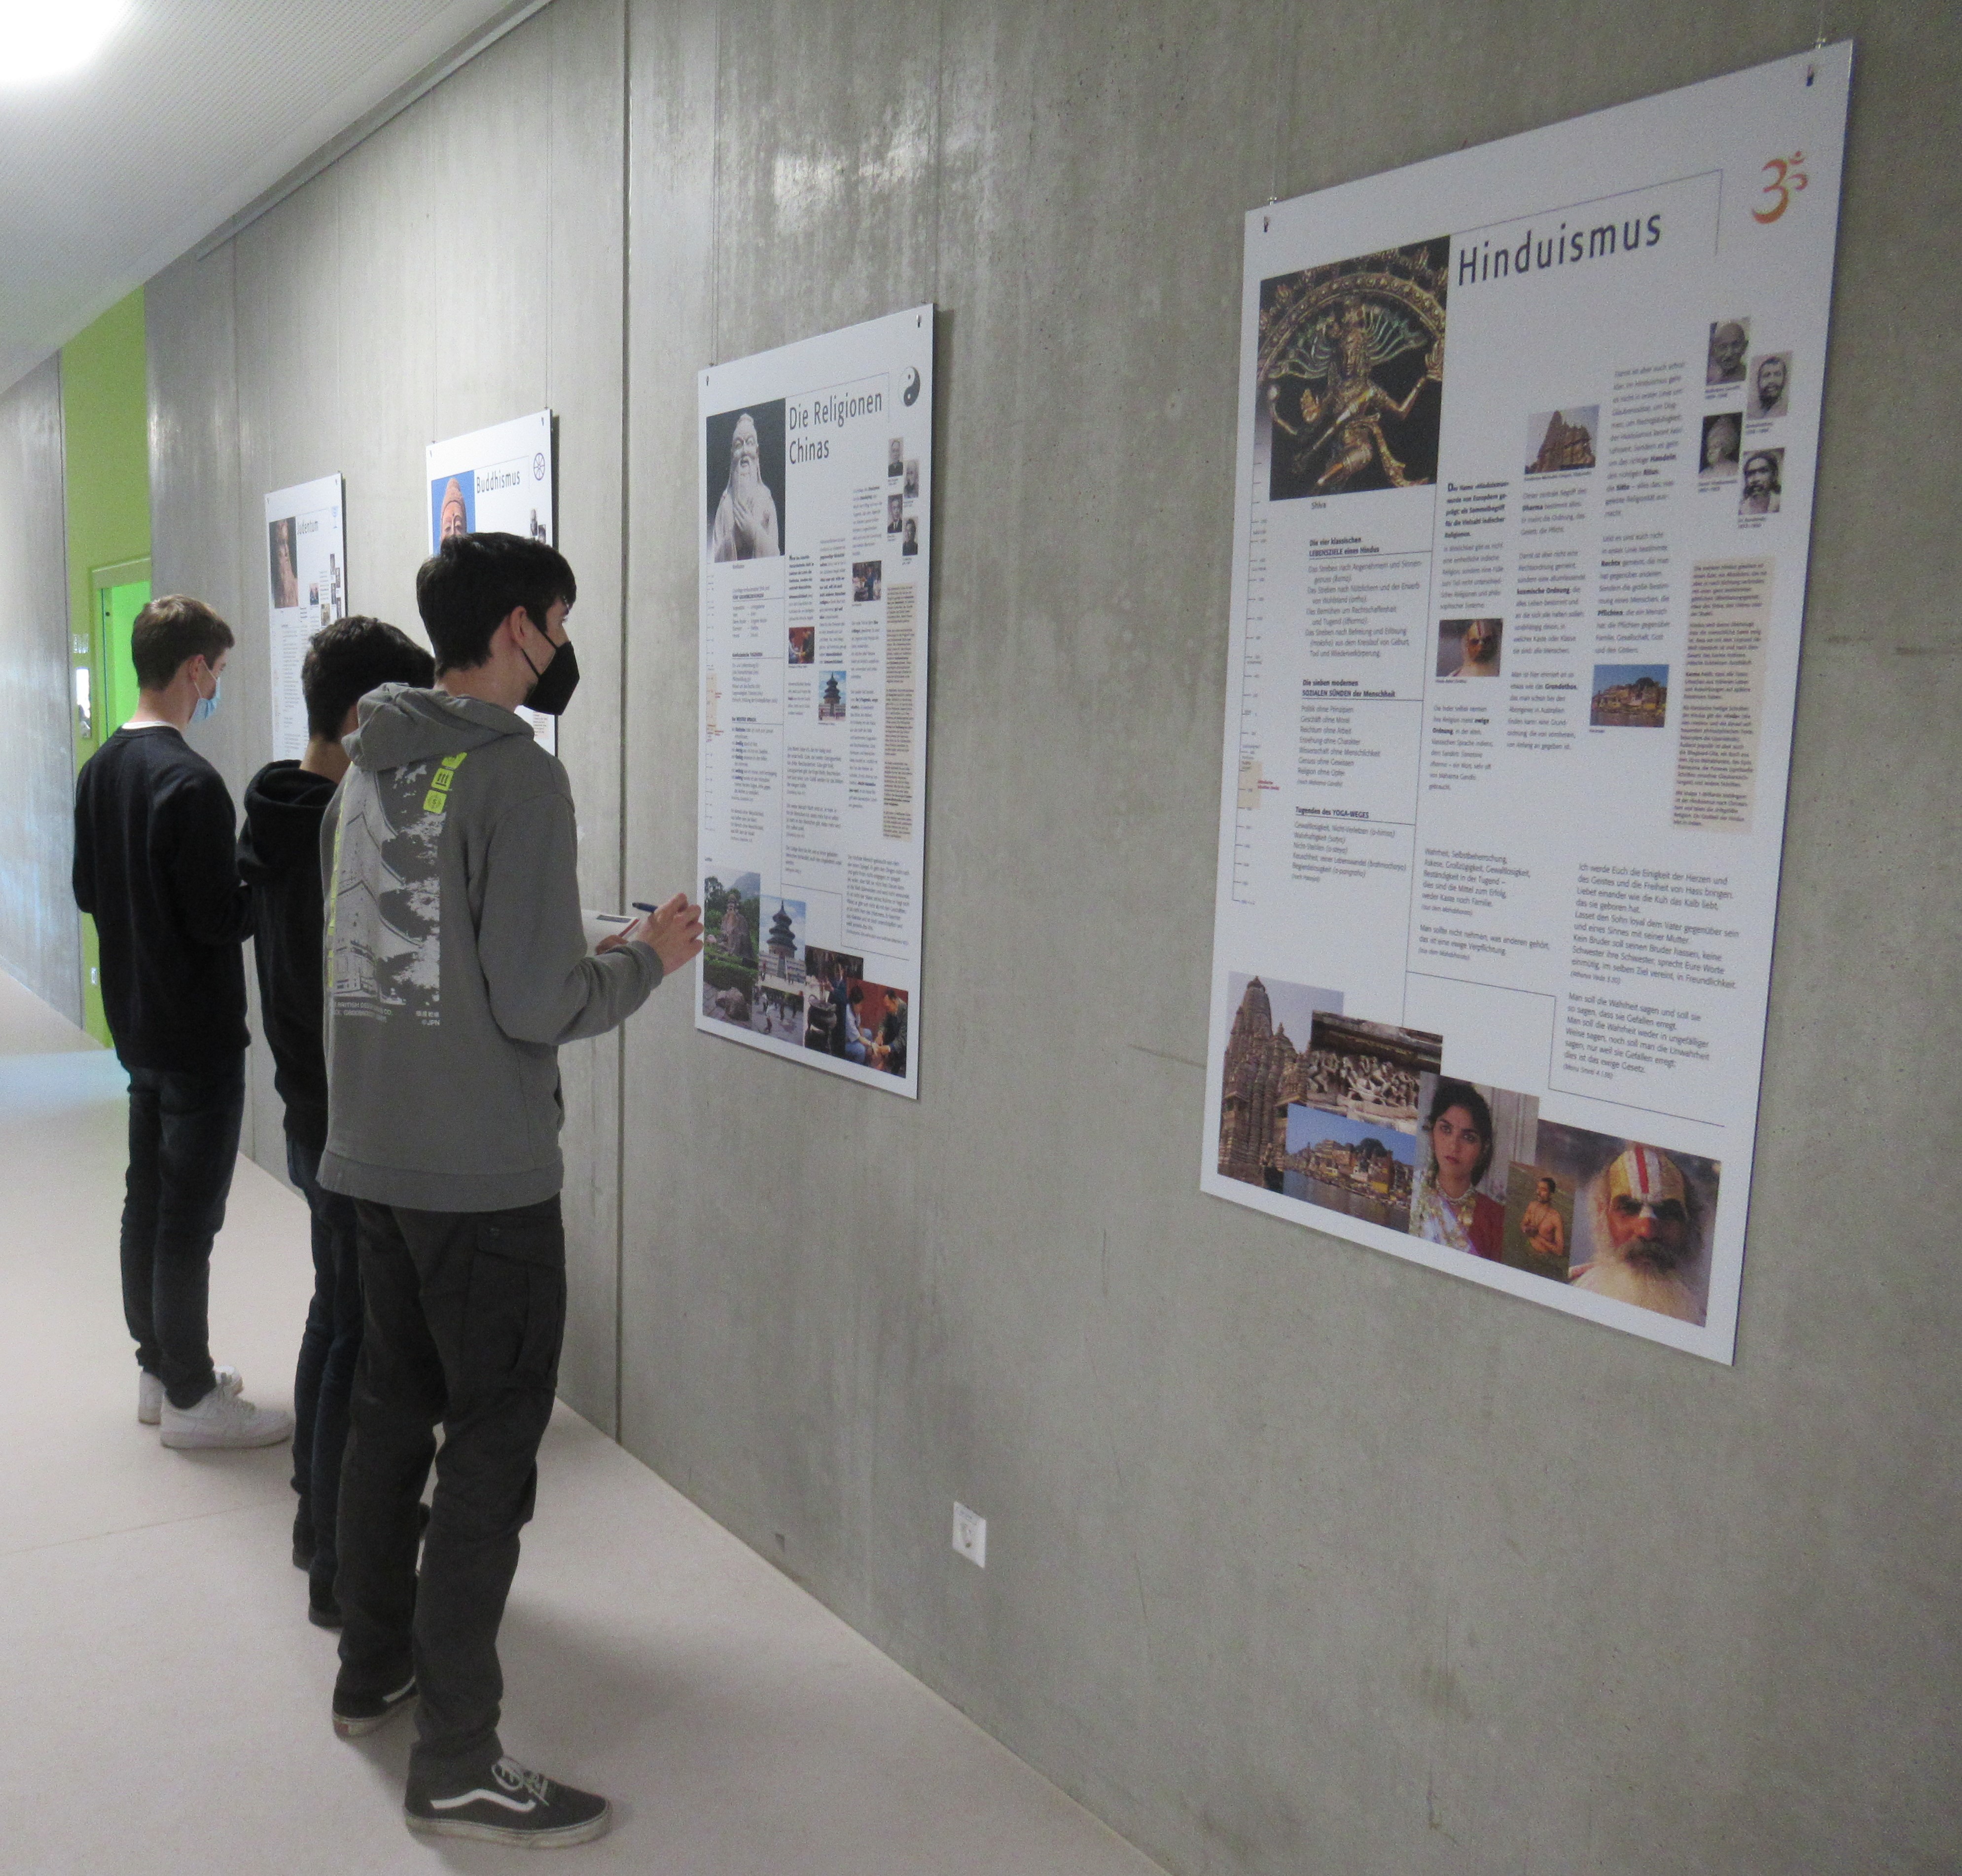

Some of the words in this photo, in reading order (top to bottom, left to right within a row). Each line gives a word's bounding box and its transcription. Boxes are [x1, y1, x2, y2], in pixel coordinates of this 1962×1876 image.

[1458, 214, 1661, 286] Hinduismus
[789, 404, 808, 430] Die
[814, 393, 882, 428] Religionen
[789, 437, 829, 465] Chinas
[476, 470, 520, 493] Buddhismus
[1295, 806, 1320, 815] Tugenden
[1332, 809, 1369, 818] YOGA-WEGES
